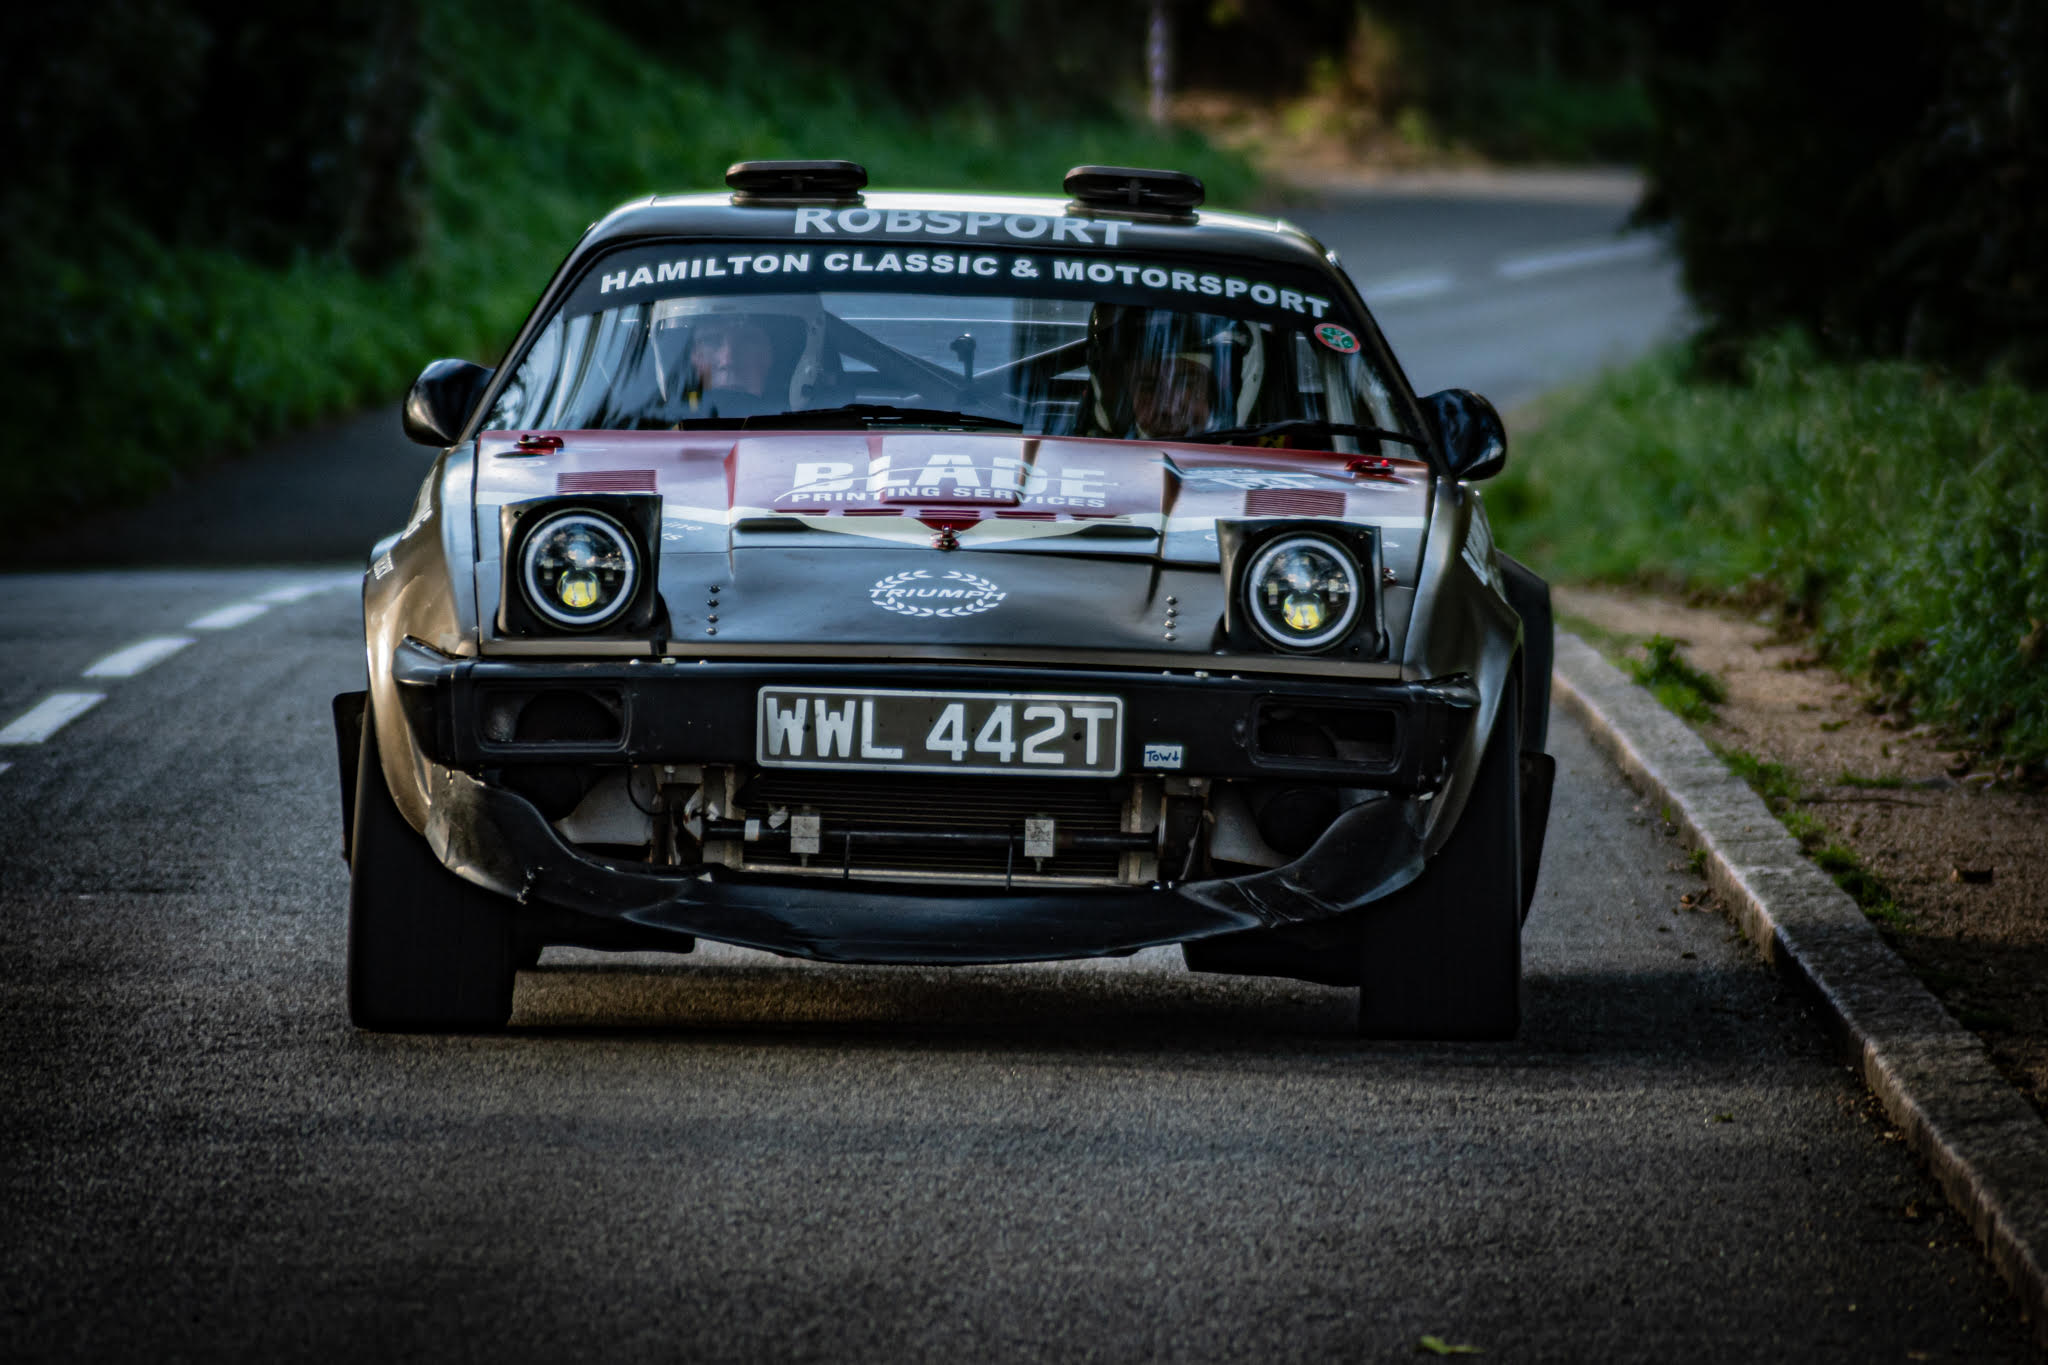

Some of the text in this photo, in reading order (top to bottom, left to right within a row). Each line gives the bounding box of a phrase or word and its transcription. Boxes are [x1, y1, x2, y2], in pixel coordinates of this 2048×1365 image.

[794, 207, 1132, 245] ROBSPORT
[601, 254, 1329, 318] HAMILTON CLASSIC & MOTORSPORT
[793, 454, 1106, 499] BLADE
[792, 487, 1105, 508] PRINTING SERVICES
[869, 587, 1007, 601] TRIUMPH
[767, 698, 1114, 765] WWL 442T
